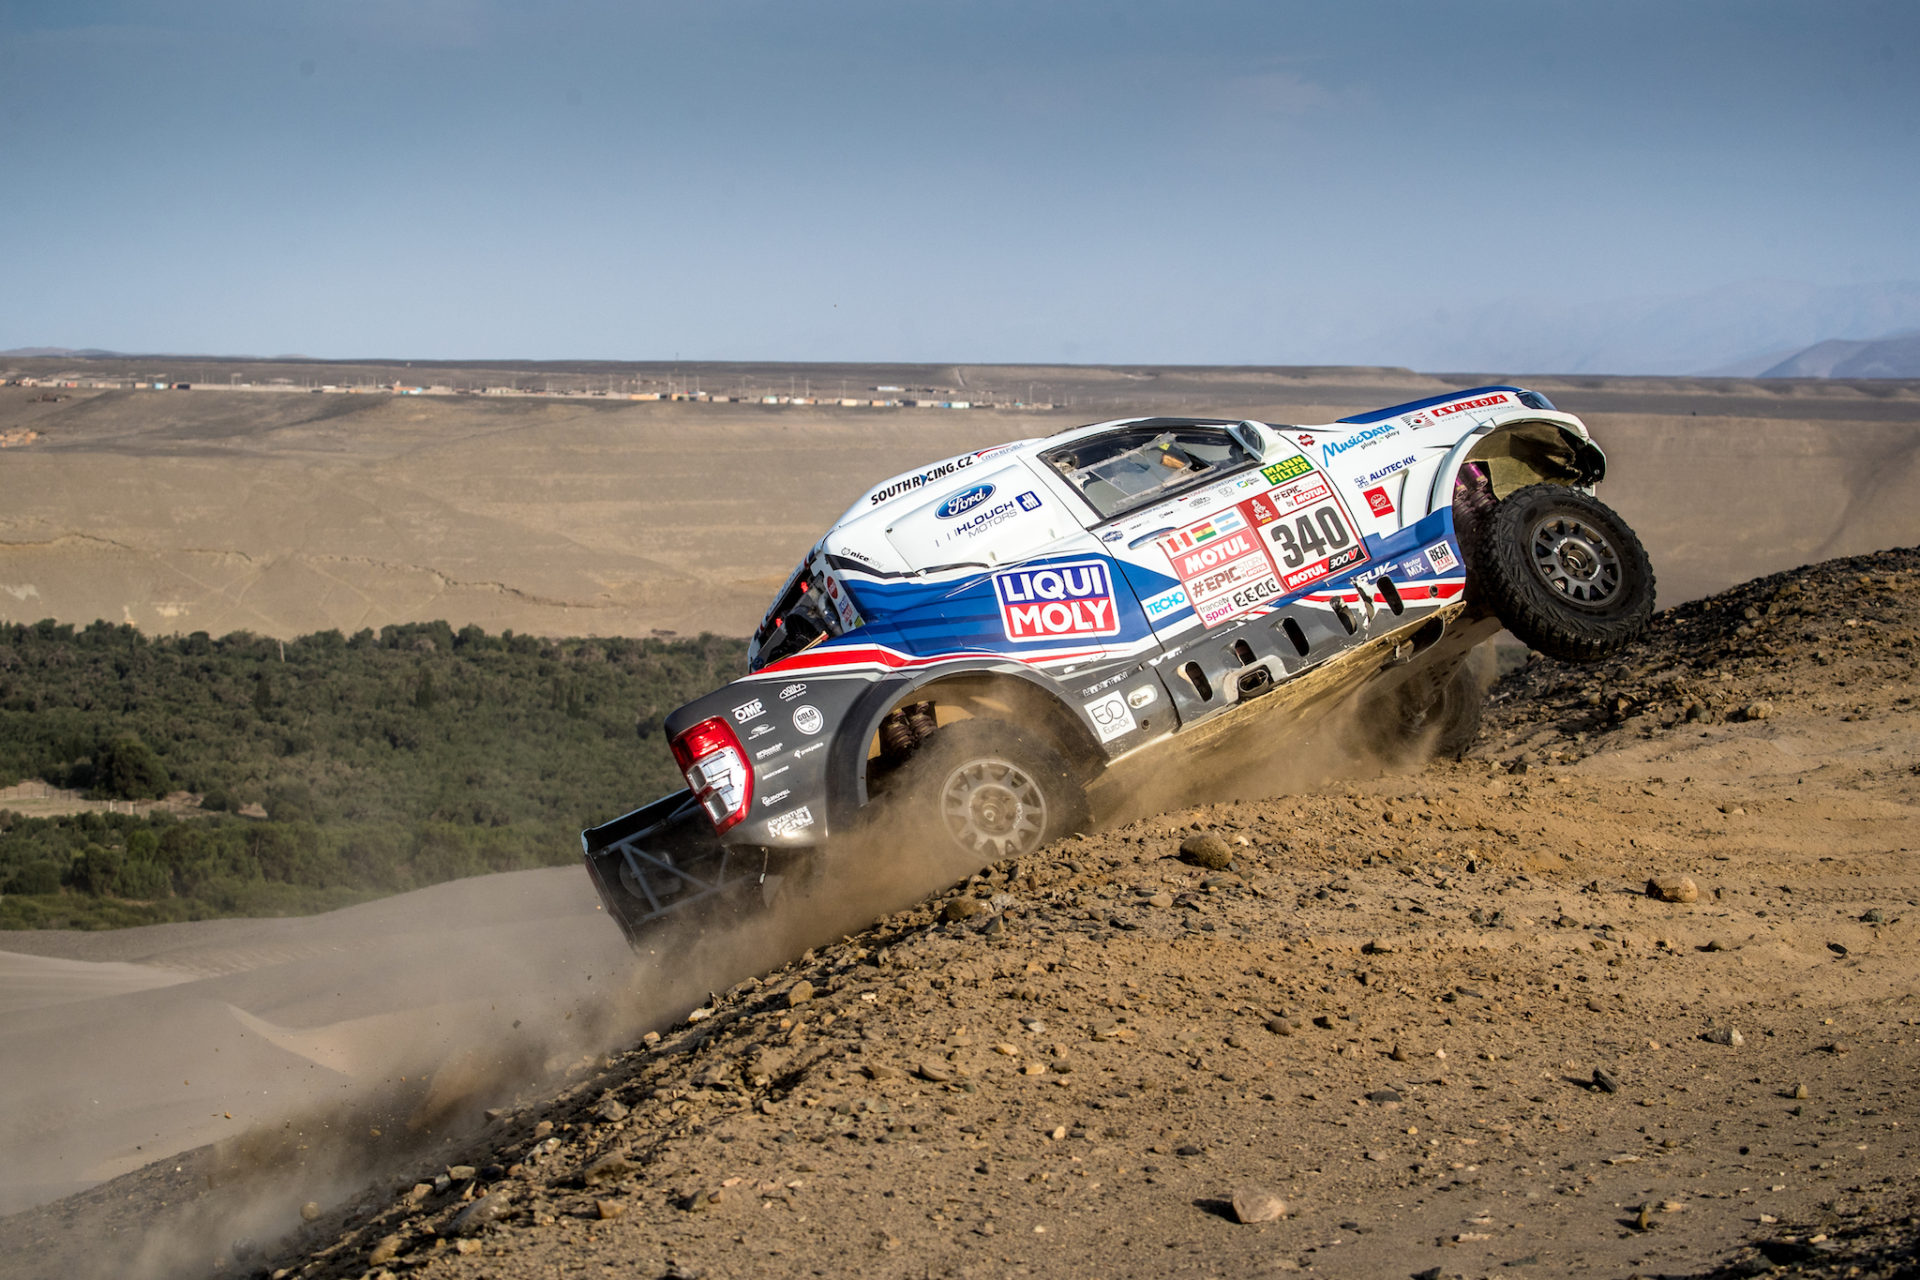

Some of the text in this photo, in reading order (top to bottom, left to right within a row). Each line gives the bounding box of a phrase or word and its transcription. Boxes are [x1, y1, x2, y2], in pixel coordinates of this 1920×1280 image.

[1263, 455, 1305, 477] MANN
[1270, 462, 1312, 484] FILTER
[1369, 455, 1417, 482] ALUTEC KK
[947, 487, 987, 515] Ford
[1294, 486, 1327, 504] MOTUL
[956, 500, 1016, 536] HLOUCH
[967, 508, 1018, 539] MOTORS
[1270, 505, 1350, 569] 340
[1183, 535, 1251, 576] MOTUL
[1428, 542, 1450, 562] BEAT
[1287, 547, 1359, 587] MOTUL 300V
[1001, 565, 1104, 602] LIQUI
[1009, 598, 1111, 636] MOLY
[1145, 591, 1186, 616] TECHO
[1205, 602, 1235, 622] sport
[734, 701, 763, 721] OMP
